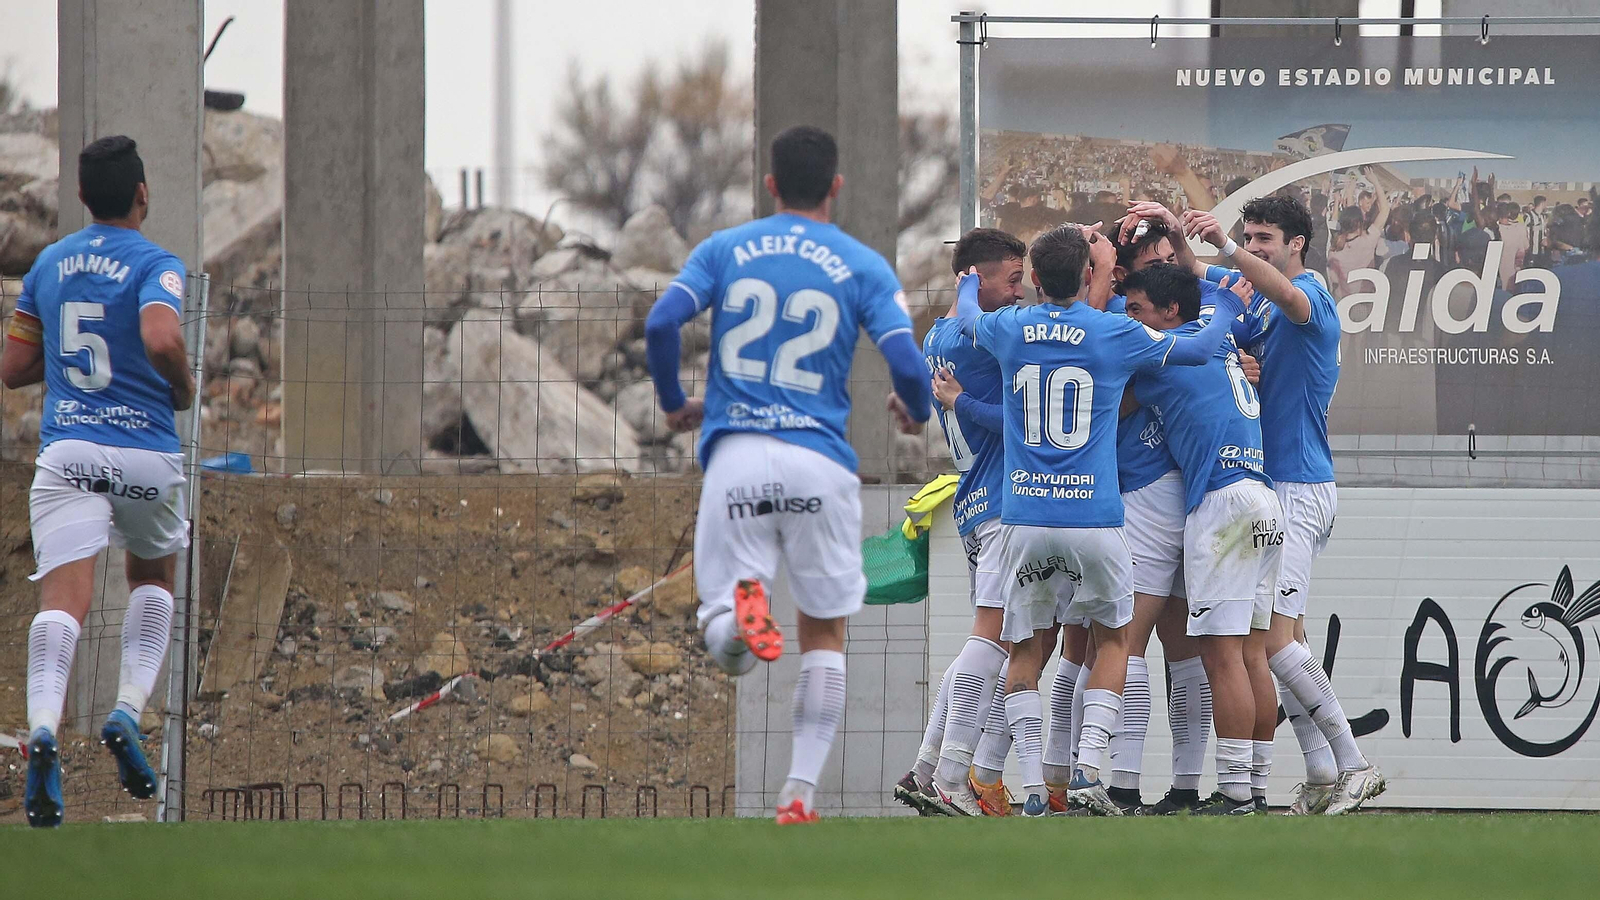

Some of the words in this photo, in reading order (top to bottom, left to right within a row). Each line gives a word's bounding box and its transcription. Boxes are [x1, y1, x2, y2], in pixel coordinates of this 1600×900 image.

[1176, 69, 1266, 86] NUEVO
[1278, 68, 1391, 86] ESTADIO
[1404, 67, 1556, 85] MUNICIPAL
[57, 253, 131, 284] JUANMA
[1305, 240, 1562, 334] aida
[718, 277, 840, 395] 22
[1022, 323, 1086, 346] BRAVO
[59, 301, 112, 393] 5
[1364, 348, 1519, 364] INFRAESTRUCTURAS
[1526, 348, 1555, 365] S.A.
[1012, 364, 1095, 450] 10
[62, 463, 123, 482] KILLER
[1032, 473, 1095, 485] HYUNDAI
[64, 477, 159, 501] mouse
[725, 482, 785, 502] KILLER
[1052, 486, 1095, 499] Motor
[728, 497, 822, 519] mouse
[1015, 555, 1067, 577] KILLER
